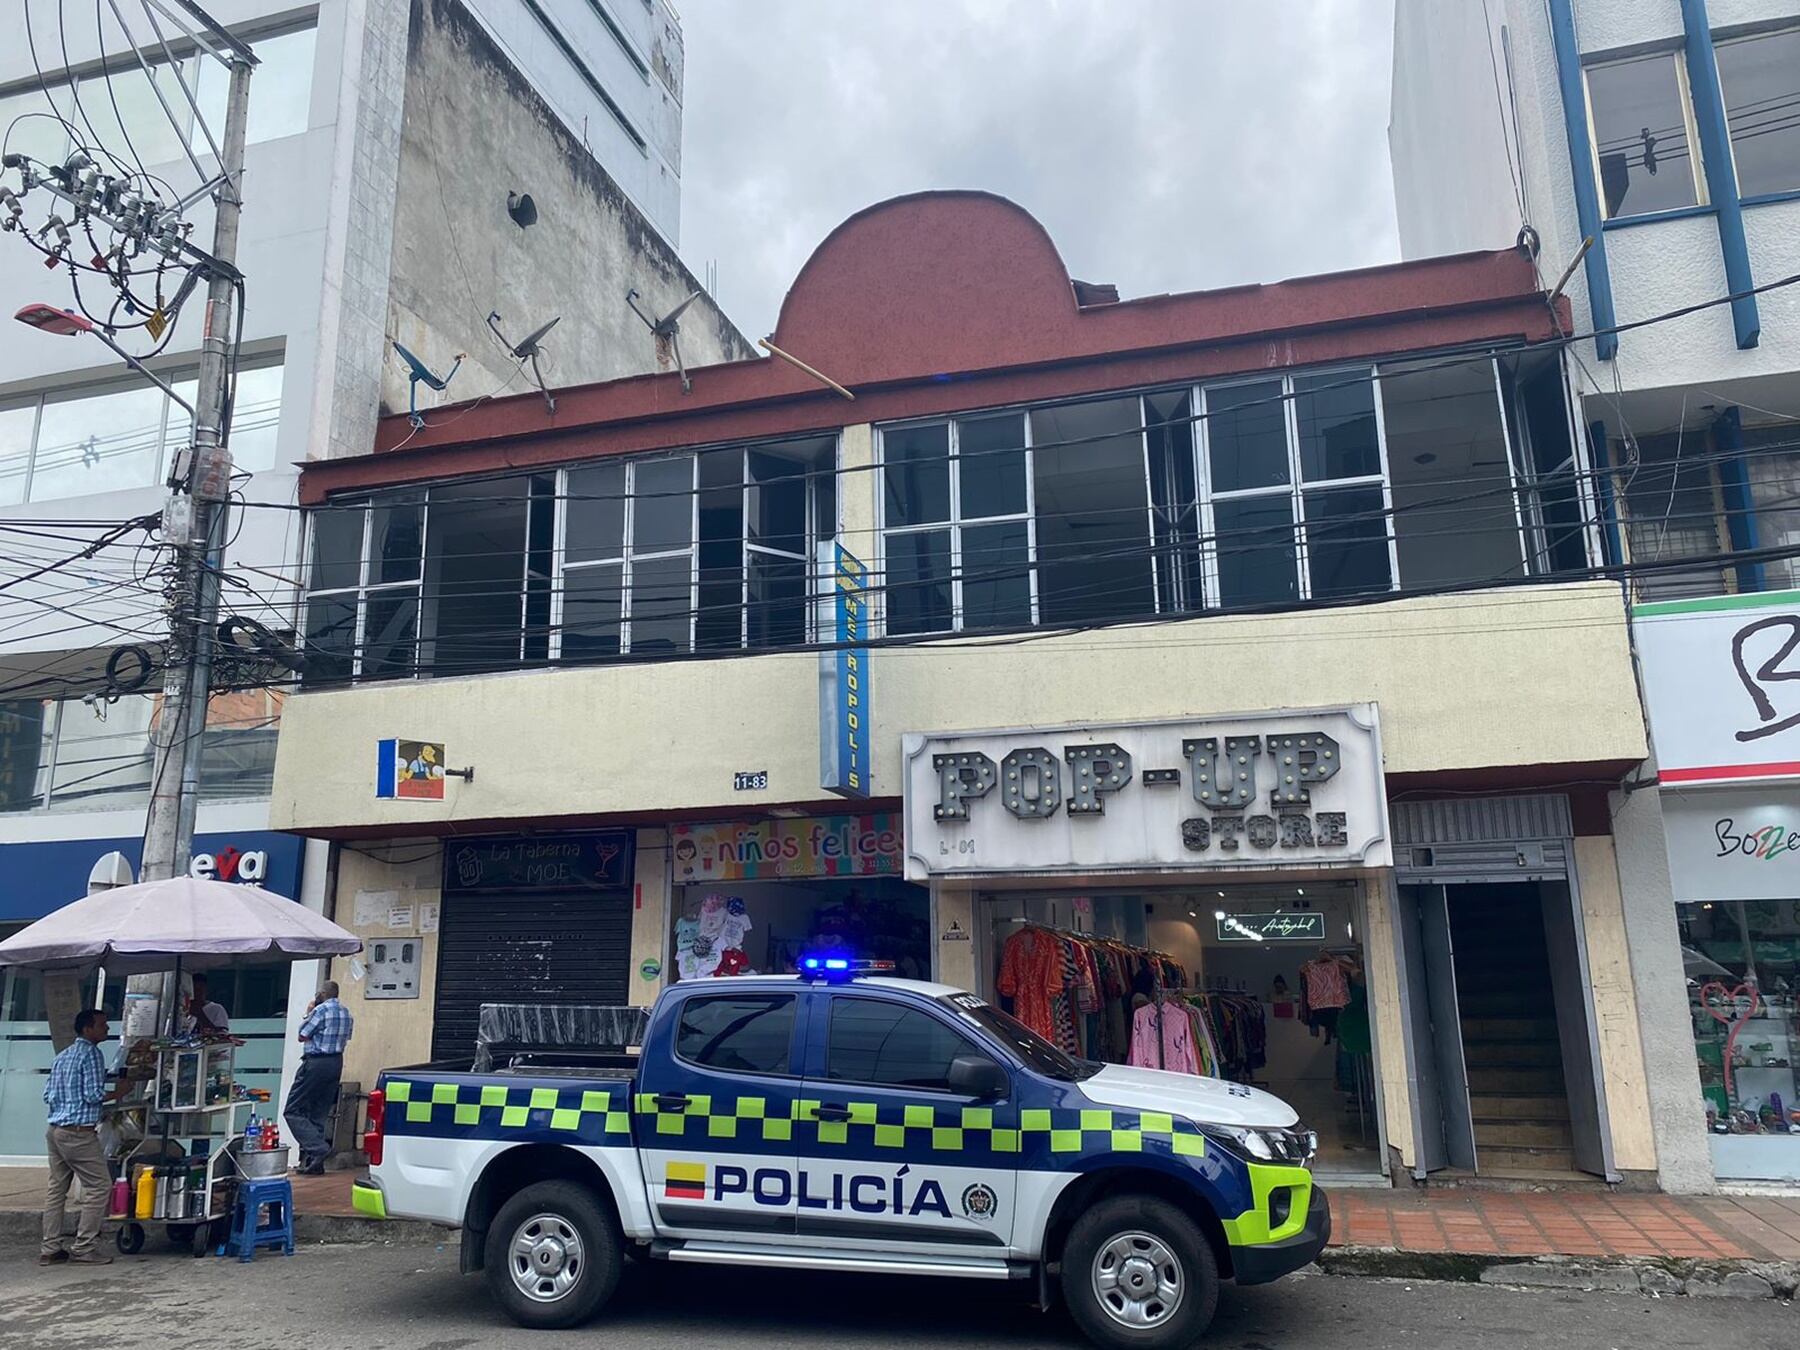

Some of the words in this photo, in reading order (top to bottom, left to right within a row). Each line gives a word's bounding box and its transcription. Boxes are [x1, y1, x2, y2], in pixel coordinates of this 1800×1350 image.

[736, 775, 766, 789] 11-83
[933, 732, 1341, 823] POP-UP
[490, 843, 510, 862] La
[514, 840, 581, 861] Taberna
[718, 831, 801, 863] niños
[808, 824, 903, 857] felice
[1181, 812, 1348, 851] STORE
[526, 863, 570, 882] MOE
[713, 1163, 953, 1219] POLICÍA
